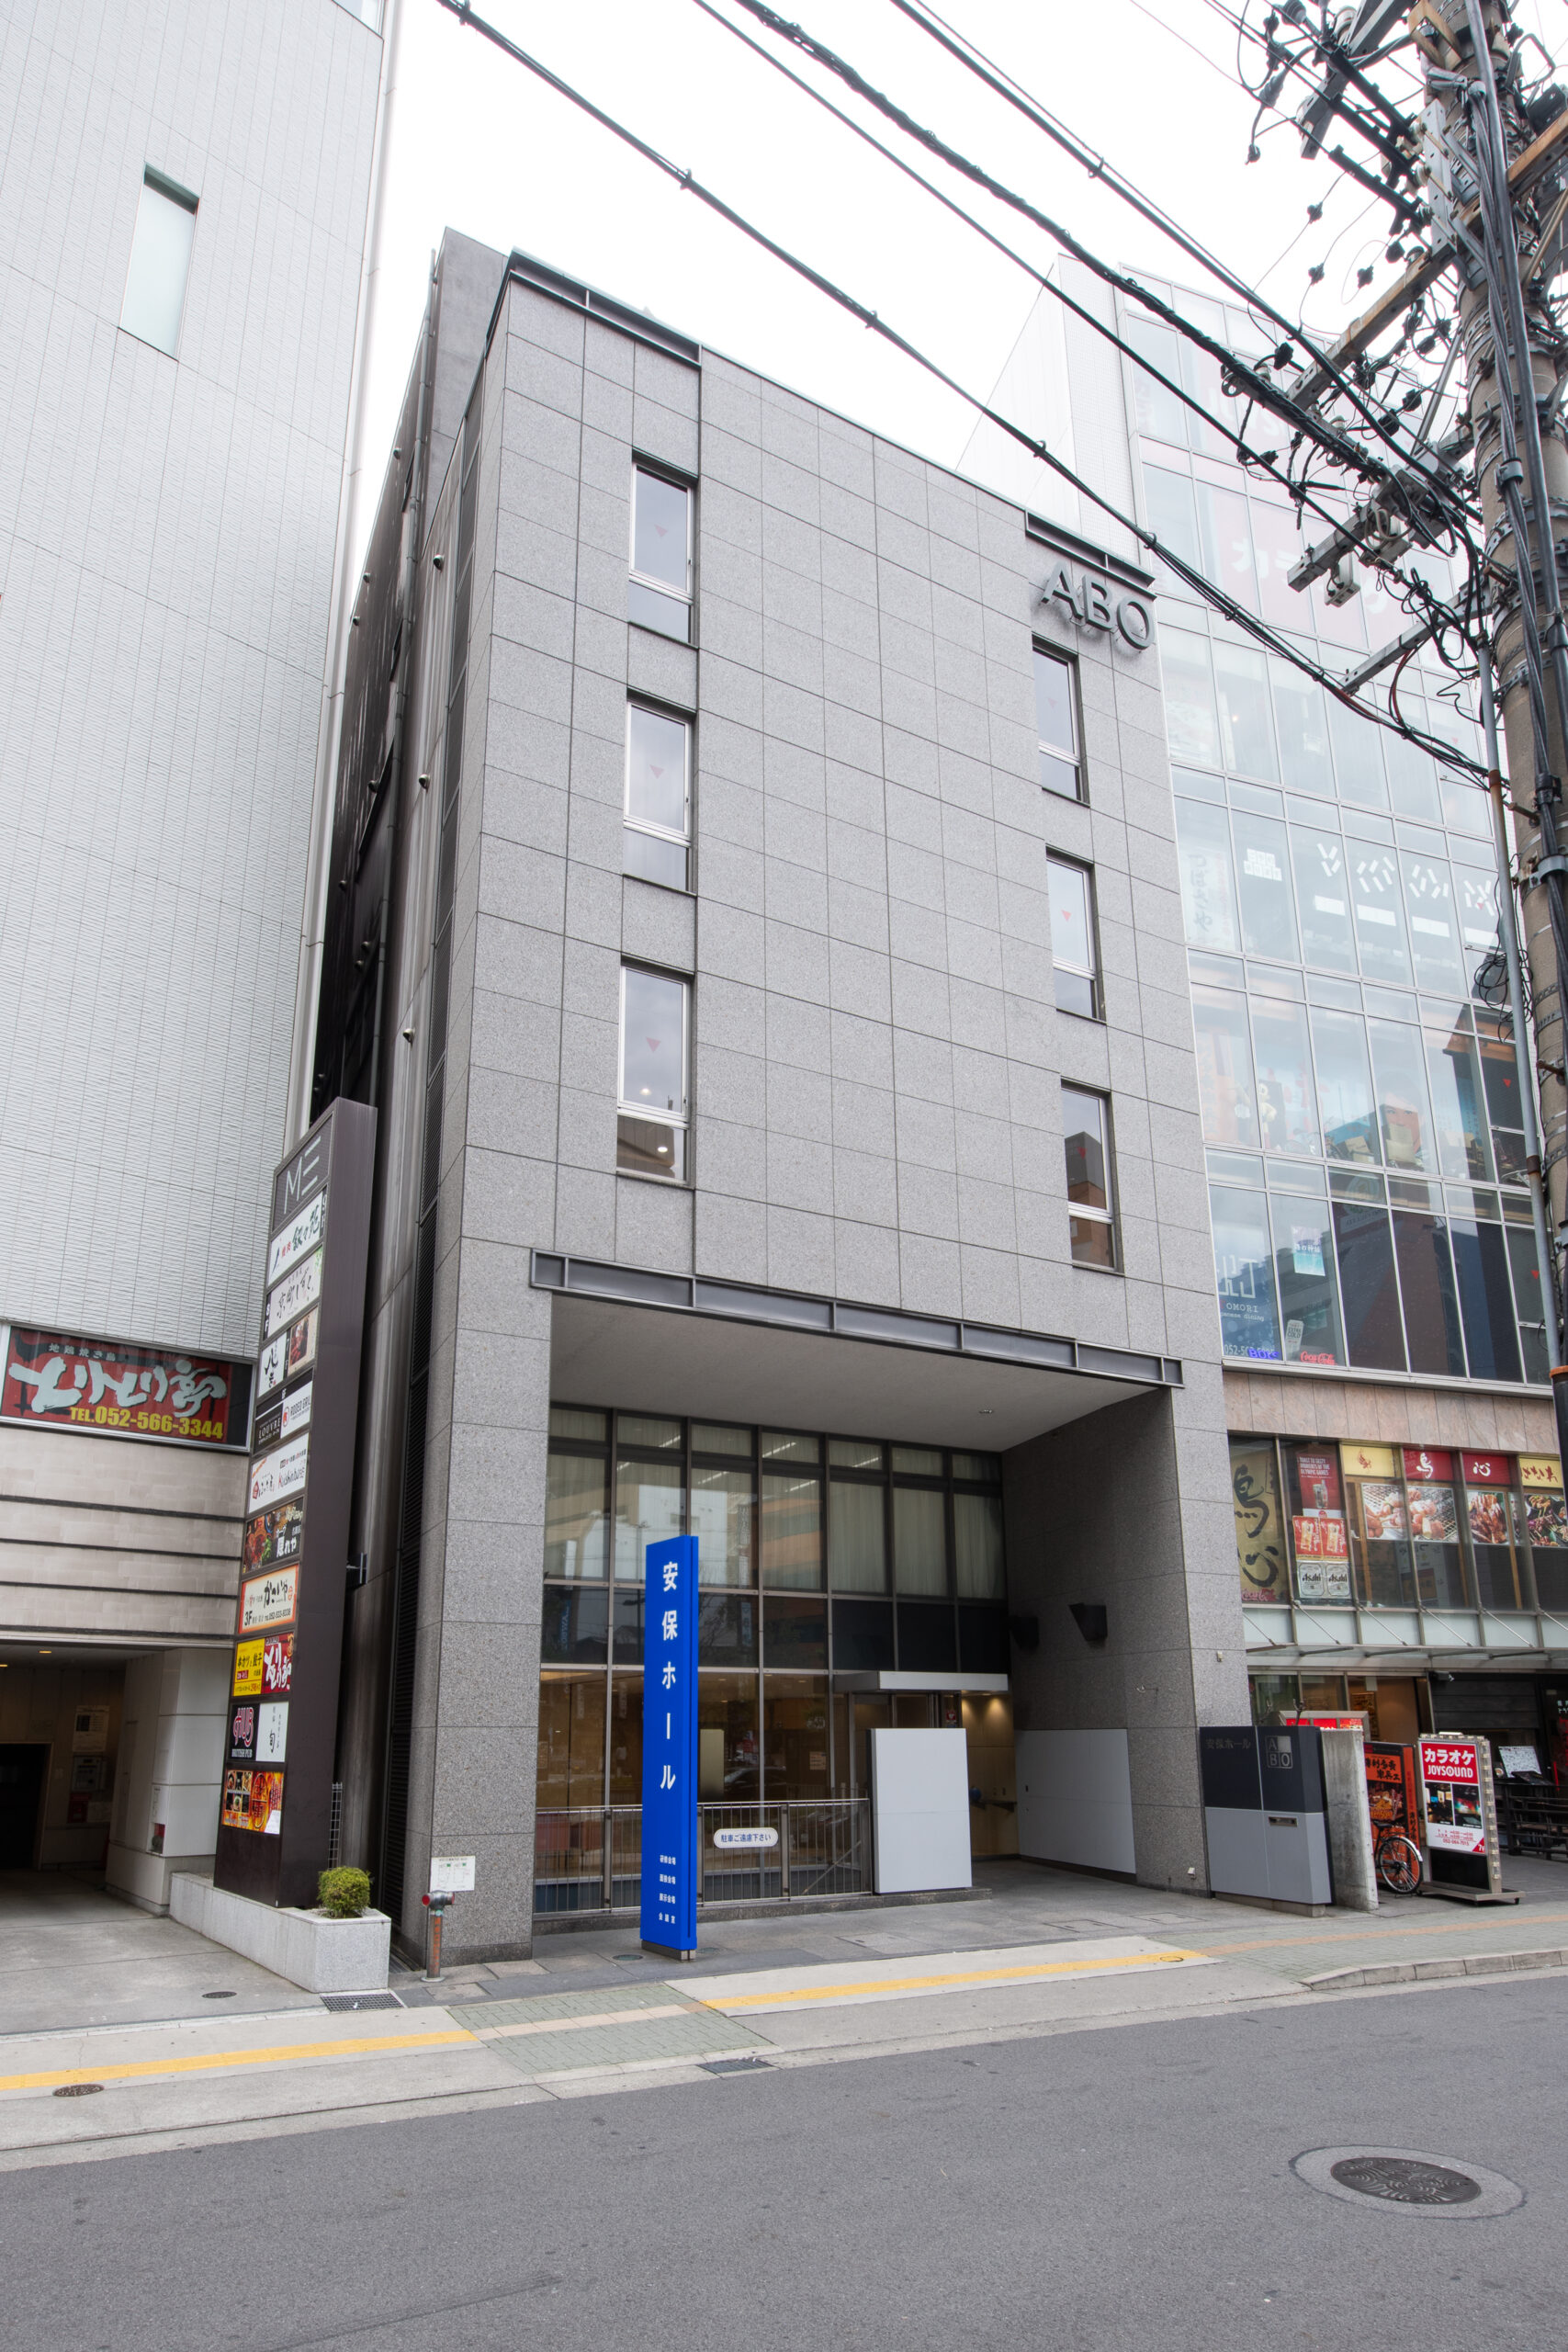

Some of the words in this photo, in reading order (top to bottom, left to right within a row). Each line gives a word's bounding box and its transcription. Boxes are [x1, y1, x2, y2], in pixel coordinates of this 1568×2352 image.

[1040, 560, 1156, 650] ABO
[1244, 1314, 1265, 1322] dining
[70, 1405, 223, 1440] TEL.052-566-3344
[258, 1417, 281, 1440] LOUVRE
[1302, 1573, 1321, 1582] Asahi
[1329, 1574, 1348, 1583] Asahi
[244, 1611, 253, 1626] 3F
[660, 1560, 679, 1792] 安保ホール
[233, 1707, 254, 1747] HUB
[1206, 1738, 1252, 1750] 安保ホール
[1425, 1748, 1474, 1765] カラオケ
[1427, 1765, 1473, 1778] JOYSOUND
[720, 1832, 772, 1843] 駐車ご遠慮下さい
[659, 1893, 676, 1905] 展示会場
